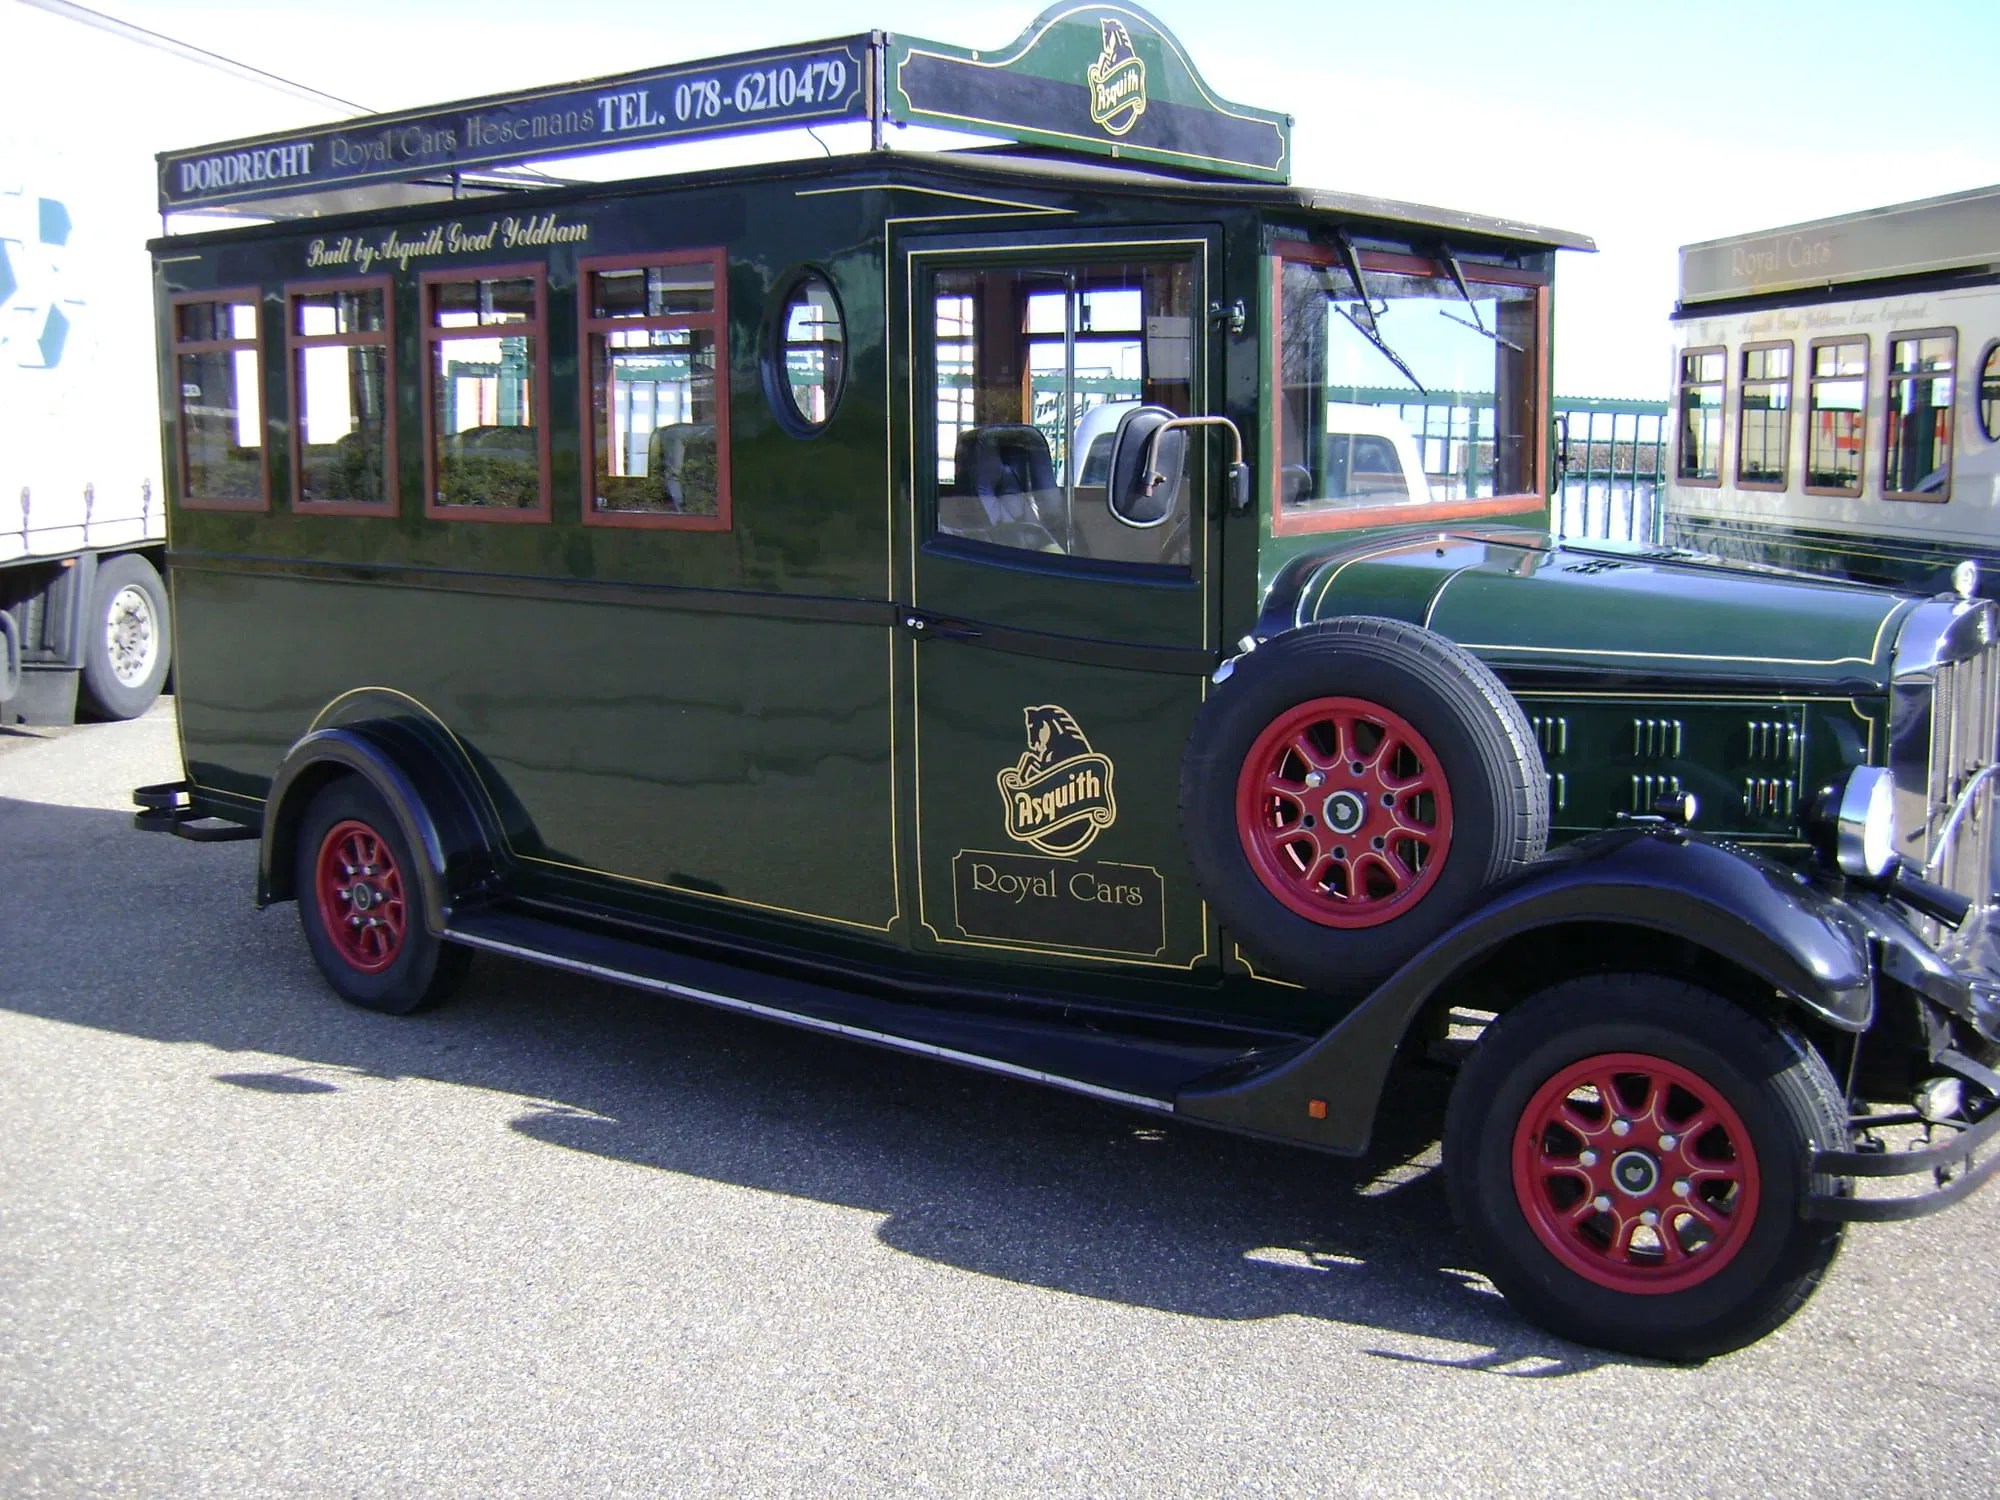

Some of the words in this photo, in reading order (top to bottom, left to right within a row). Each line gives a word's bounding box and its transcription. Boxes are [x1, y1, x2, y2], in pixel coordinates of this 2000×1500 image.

[1096, 68, 1139, 111] Asquith
[180, 142, 314, 193] DORDRECHT
[331, 133, 393, 172] Royal
[400, 125, 457, 158] Cars
[465, 107, 594, 147] Hesemans
[598, 91, 666, 132] TEL.
[674, 60, 846, 122] 078-6210479
[306, 236, 352, 268] Built
[354, 237, 376, 273] by
[375, 226, 444, 271] Asquith
[447, 222, 498, 253] Great
[501, 213, 588, 249] Yeldham
[1731, 240, 1779, 284] Royal
[1786, 237, 1832, 267] Cars
[1014, 769, 1100, 827] Asquith
[971, 863, 1058, 904] Royal
[1068, 872, 1144, 907] Cars
